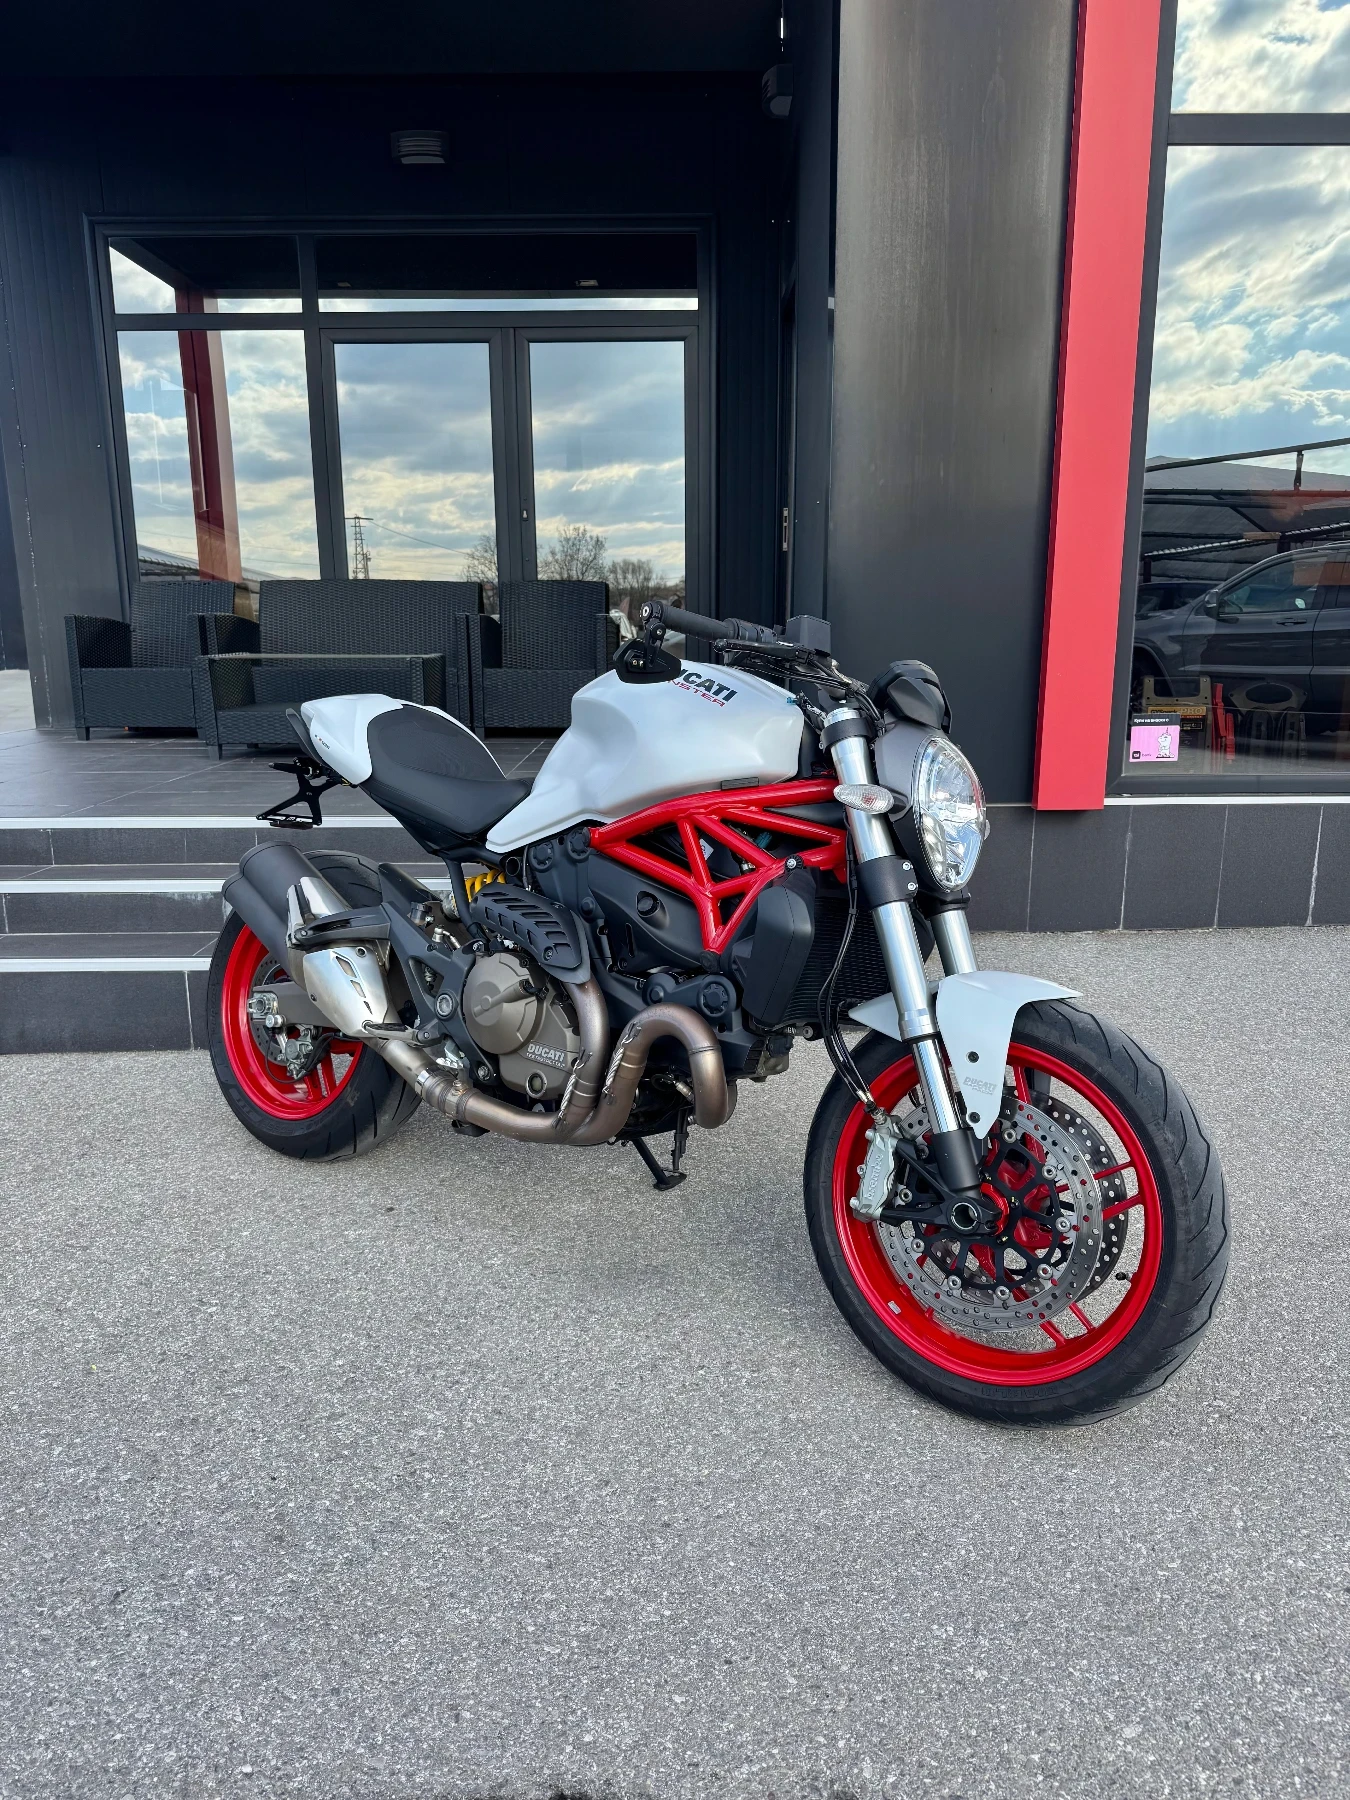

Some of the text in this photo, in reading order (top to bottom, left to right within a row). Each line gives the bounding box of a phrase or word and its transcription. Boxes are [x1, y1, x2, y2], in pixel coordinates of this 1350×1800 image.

[528, 1044, 565, 1062] DUCATI
[963, 1076, 998, 1092] DUCATI
[864, 1154, 884, 1200] brembo
